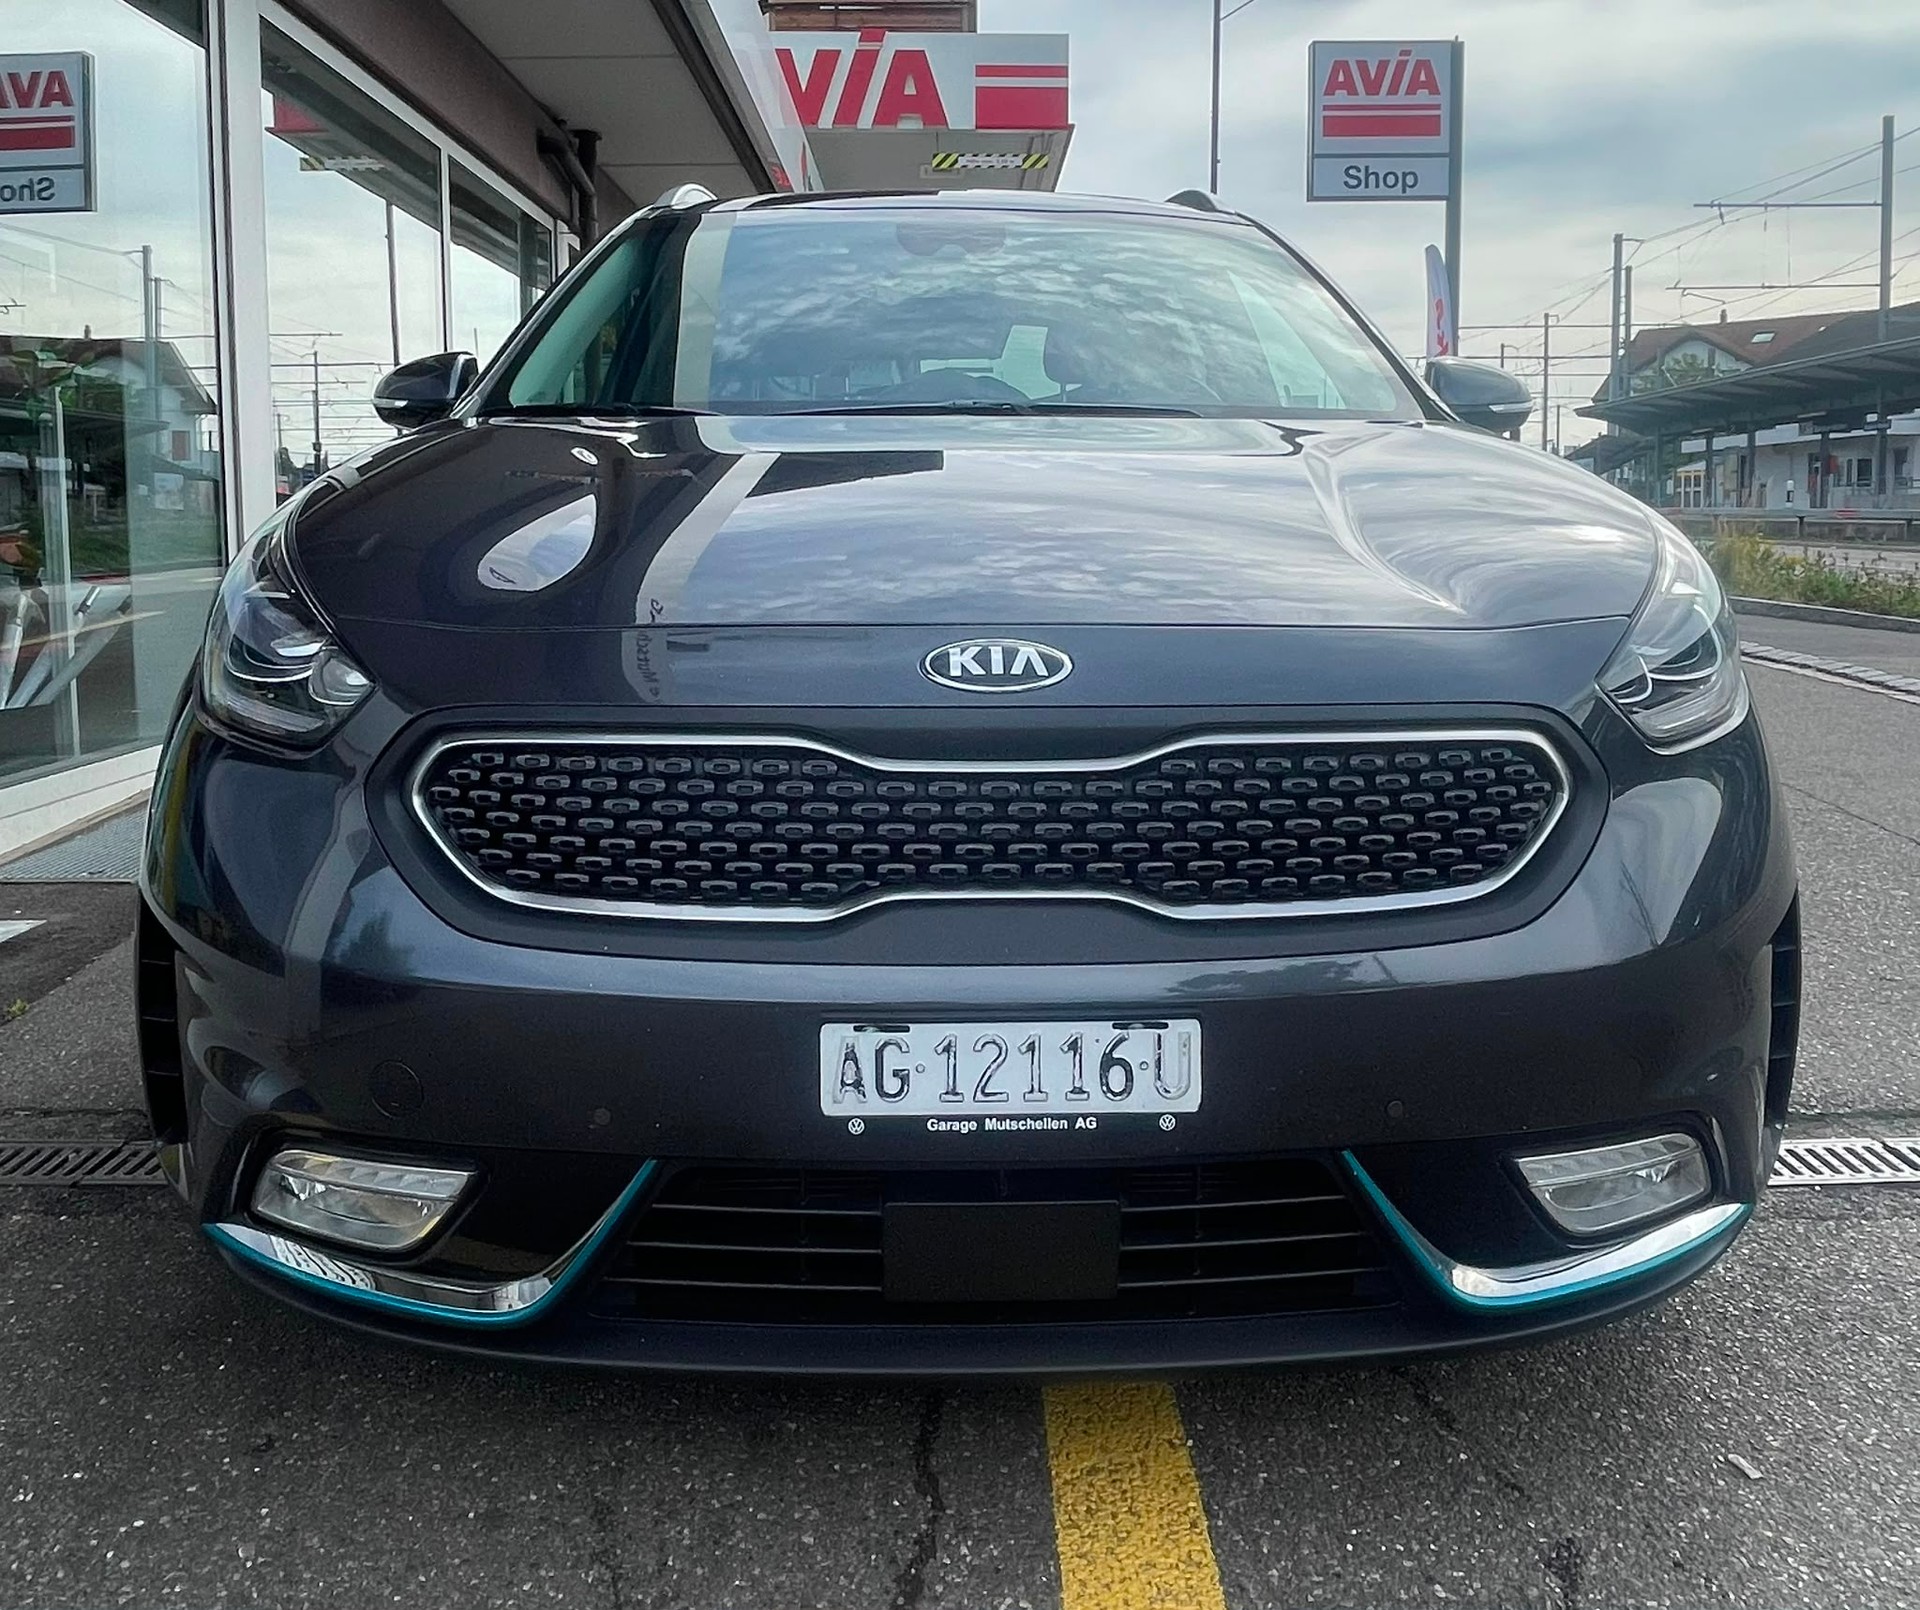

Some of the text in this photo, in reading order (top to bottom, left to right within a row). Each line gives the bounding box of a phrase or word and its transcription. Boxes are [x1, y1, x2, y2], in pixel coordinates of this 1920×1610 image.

[775, 28, 947, 126] VIA
[1323, 49, 1441, 96] AVIA
[1343, 165, 1419, 194] Shop
[948, 645, 1049, 677] KIA
[926, 1116, 1098, 1134] Garage Mutschellen AG
